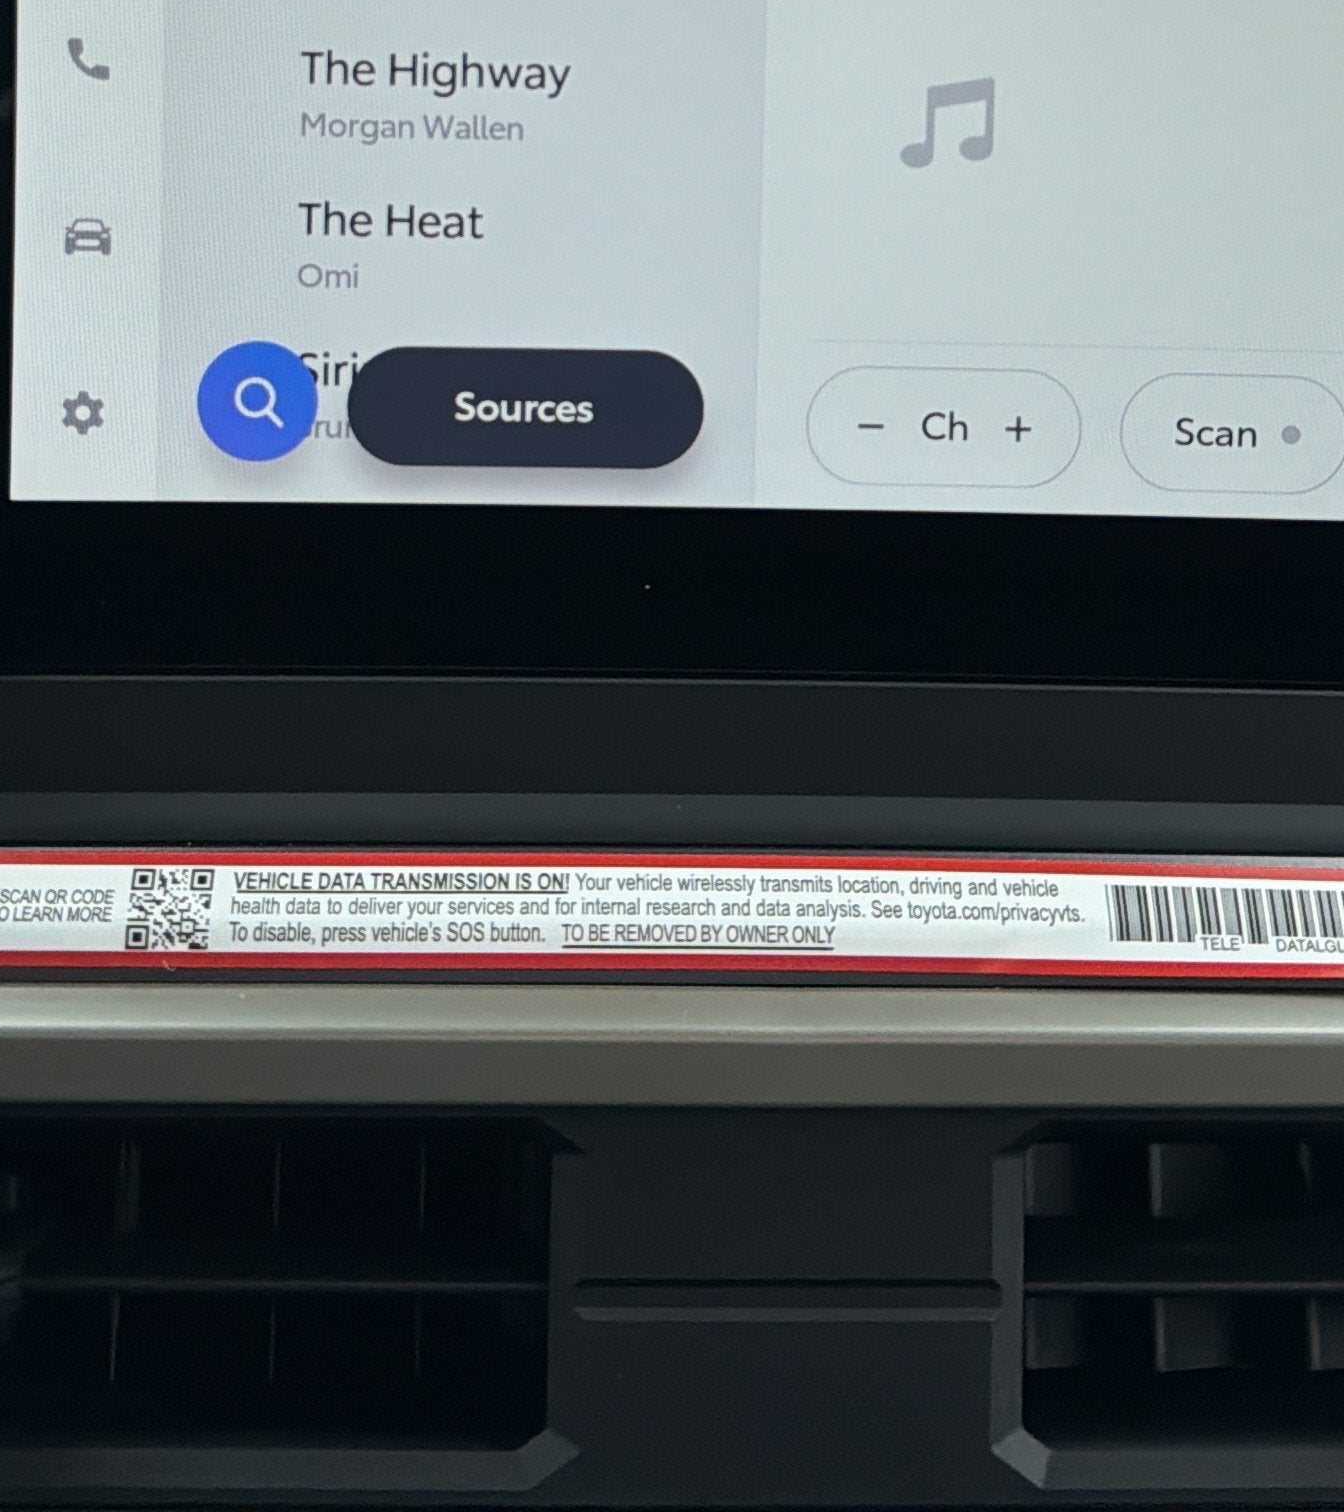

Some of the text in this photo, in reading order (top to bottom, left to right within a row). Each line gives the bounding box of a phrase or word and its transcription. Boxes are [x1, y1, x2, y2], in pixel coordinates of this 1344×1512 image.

[301, 49, 572, 99] The Highway
[301, 113, 524, 144] Morgan Wallen
[299, 200, 484, 240] The Heat
[297, 263, 359, 289] Omi
[454, 391, 594, 424] Sources
[921, 411, 969, 442] Ch
[1175, 418, 1258, 448] Scan
[0, 888, 115, 905] SCAN QR CODE
[234, 872, 1059, 899] VEHICLE DATA TRANSMISSION IS ON! Your vehicle wirelessly transmits location, driving and vehicle
[12, 906, 65, 922] LEARN
[66, 907, 113, 923] MORE
[230, 897, 1086, 927] health data to deliver your services and for internal research and data analysis. See toyota.com/privacyvts.
[229, 922, 835, 946] To disable, press vehicle's SOS button. TO BE REMOVED BY OWNER ONLY
[1200, 937, 1240, 952] TELE
